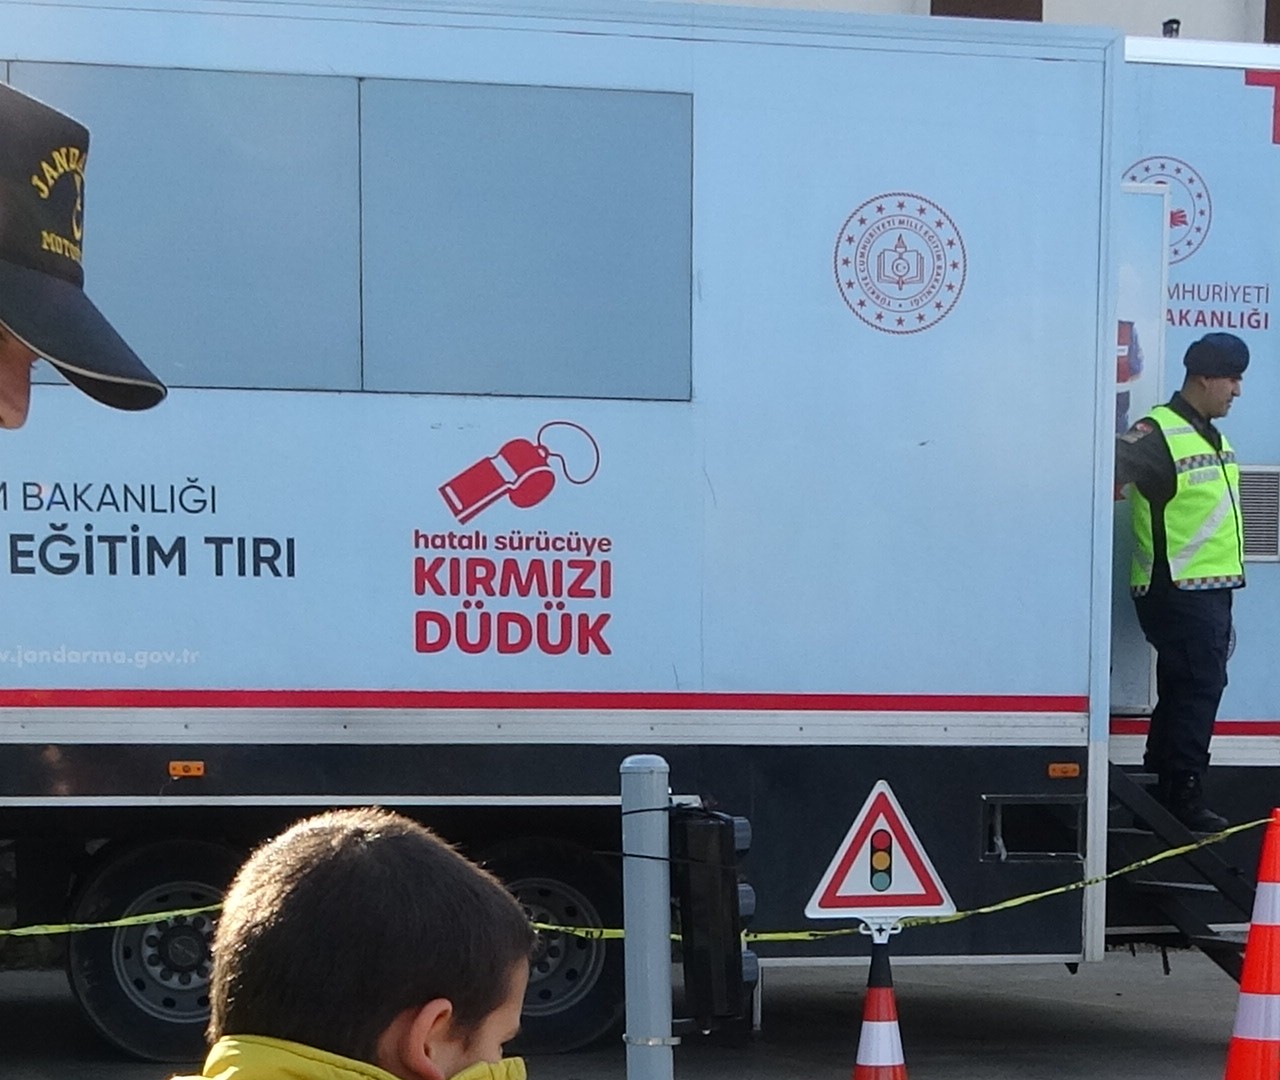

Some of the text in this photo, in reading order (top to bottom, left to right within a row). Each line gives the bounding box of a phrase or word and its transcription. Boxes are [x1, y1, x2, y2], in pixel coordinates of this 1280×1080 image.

[22, 477, 217, 514] BAKANLIĞI
[9, 523, 187, 577] EĞİTİM
[204, 536, 296, 578] TIRI
[415, 529, 612, 557] hatalı sürücüye
[414, 557, 611, 598] KIRMIZI
[415, 600, 612, 655] DÜDÜK
